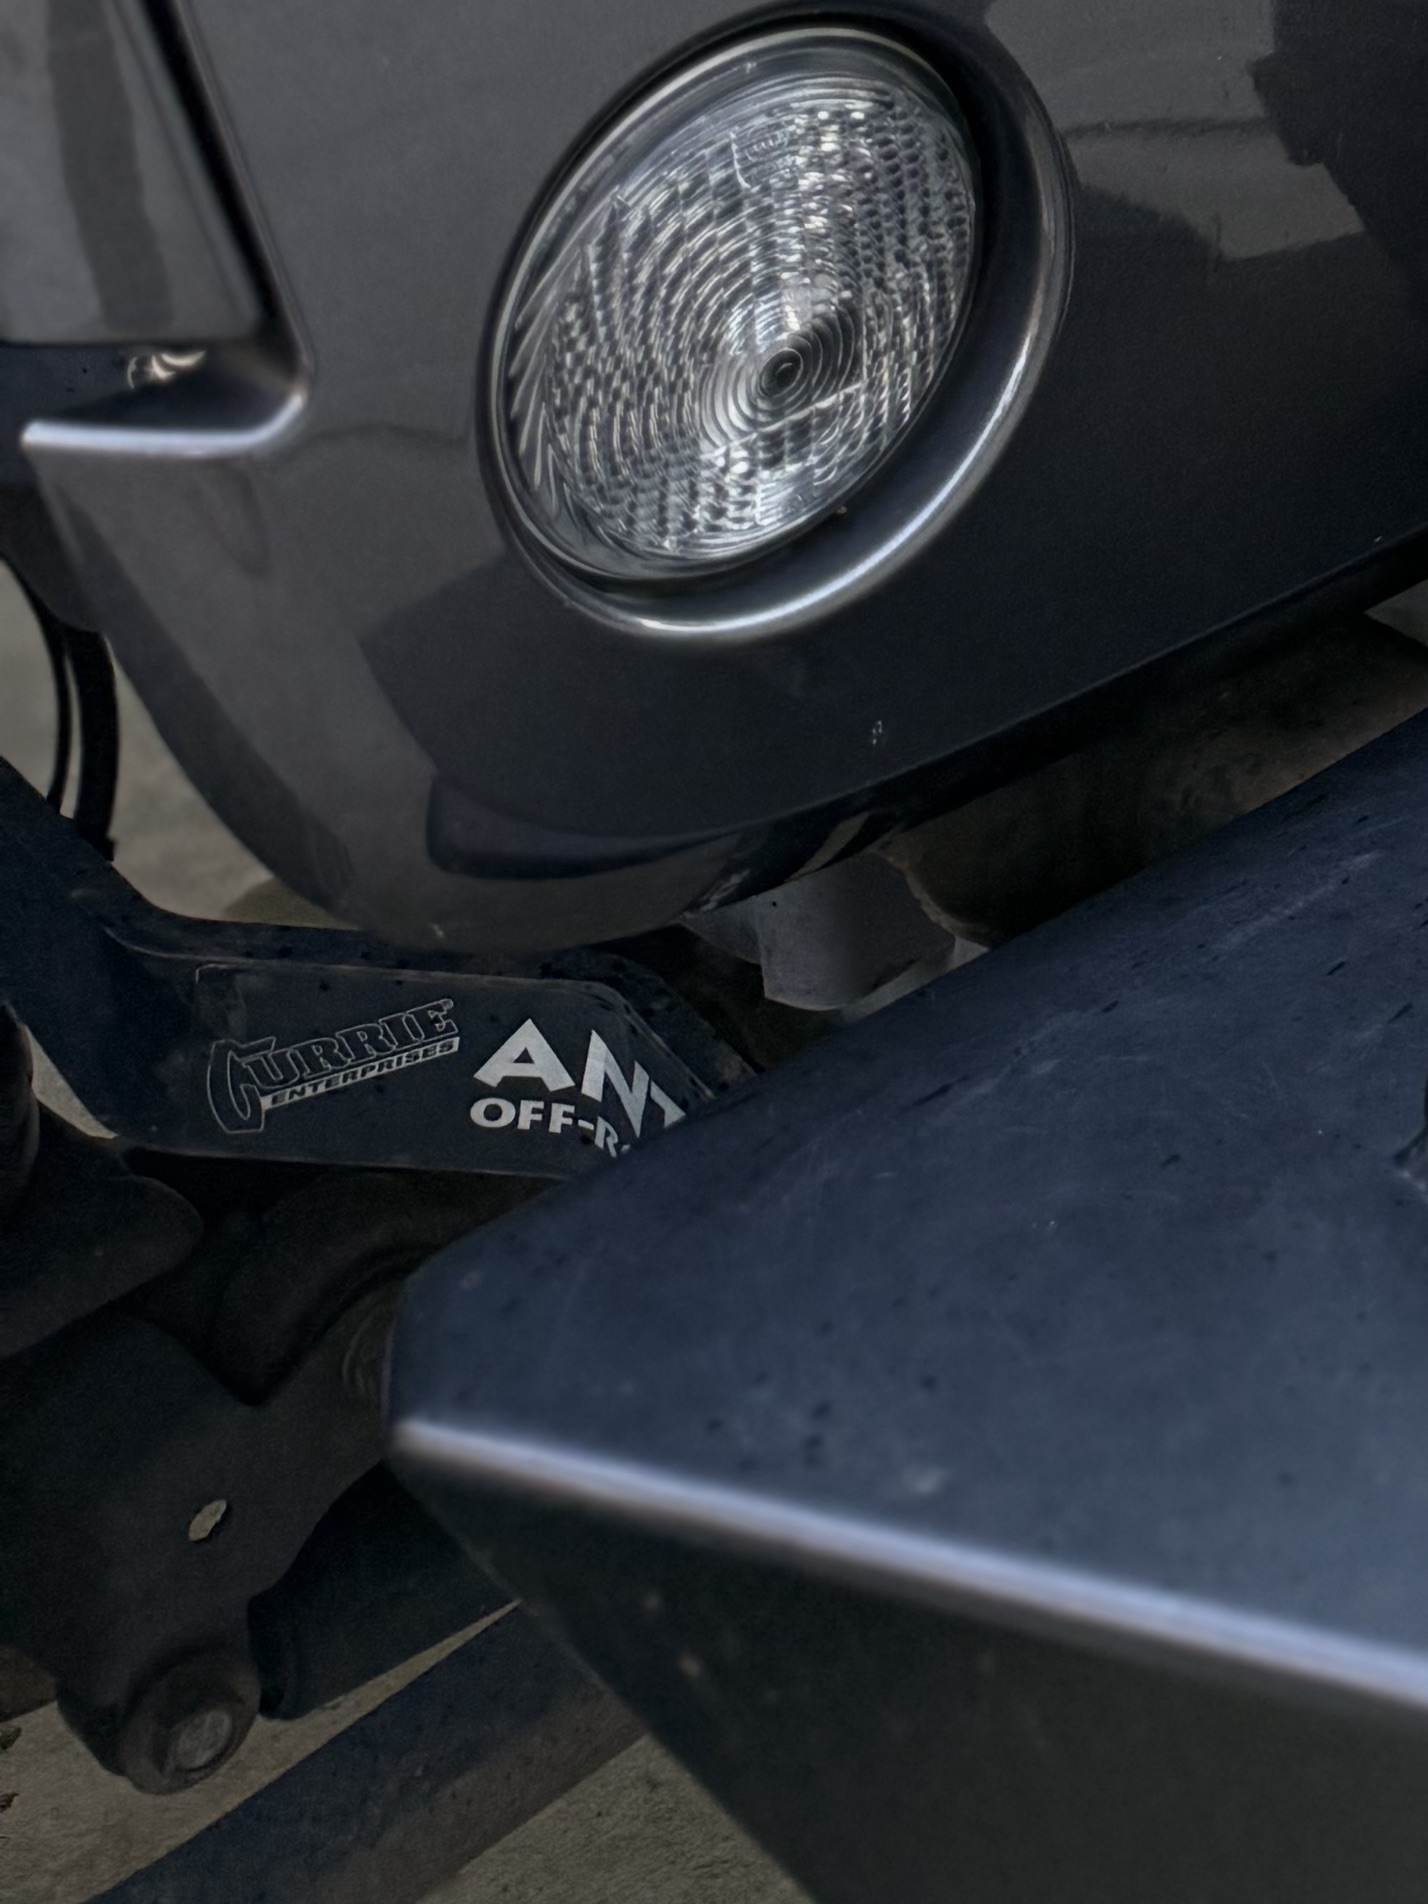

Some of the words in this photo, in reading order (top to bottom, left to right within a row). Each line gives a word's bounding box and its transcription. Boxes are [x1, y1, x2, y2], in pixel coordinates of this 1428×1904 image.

[206, 998, 459, 1134] CURRIE
[271, 1042, 454, 1106] ENTERPRISES
[469, 1097, 631, 1159] OFF-R
